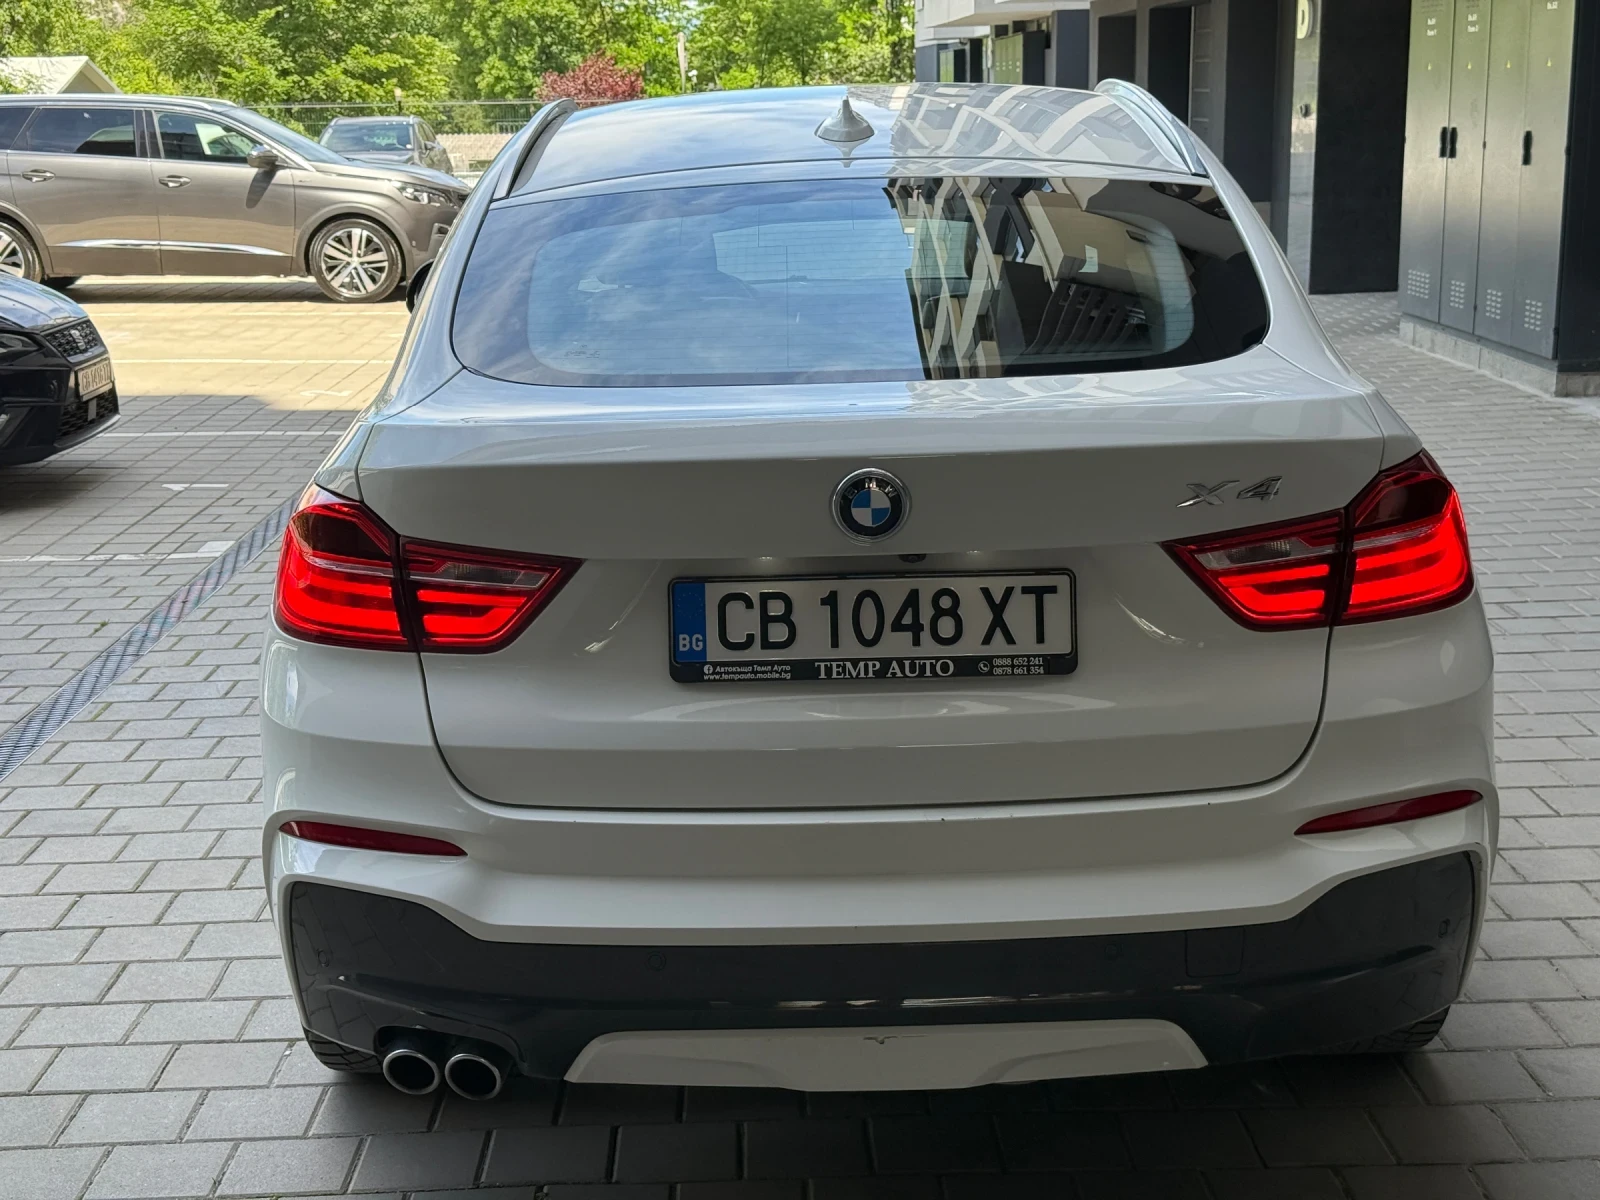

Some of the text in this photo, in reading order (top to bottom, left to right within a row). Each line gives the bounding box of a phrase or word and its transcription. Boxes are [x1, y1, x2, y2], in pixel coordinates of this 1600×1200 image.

[844, 477, 898, 499] BMW
[1176, 476, 1282, 508] X4
[717, 585, 1058, 651] CB 1048 XT
[678, 633, 704, 651] BG
[715, 665, 752, 673] Автокъща
[772, 664, 791, 673] Ауто
[814, 658, 955, 679] TEMP AUTO
[992, 656, 1044, 666] 0888 652 241
[703, 672, 792, 680] www.tempauto.mobile.bg
[992, 666, 1044, 675] 0878 661 354
